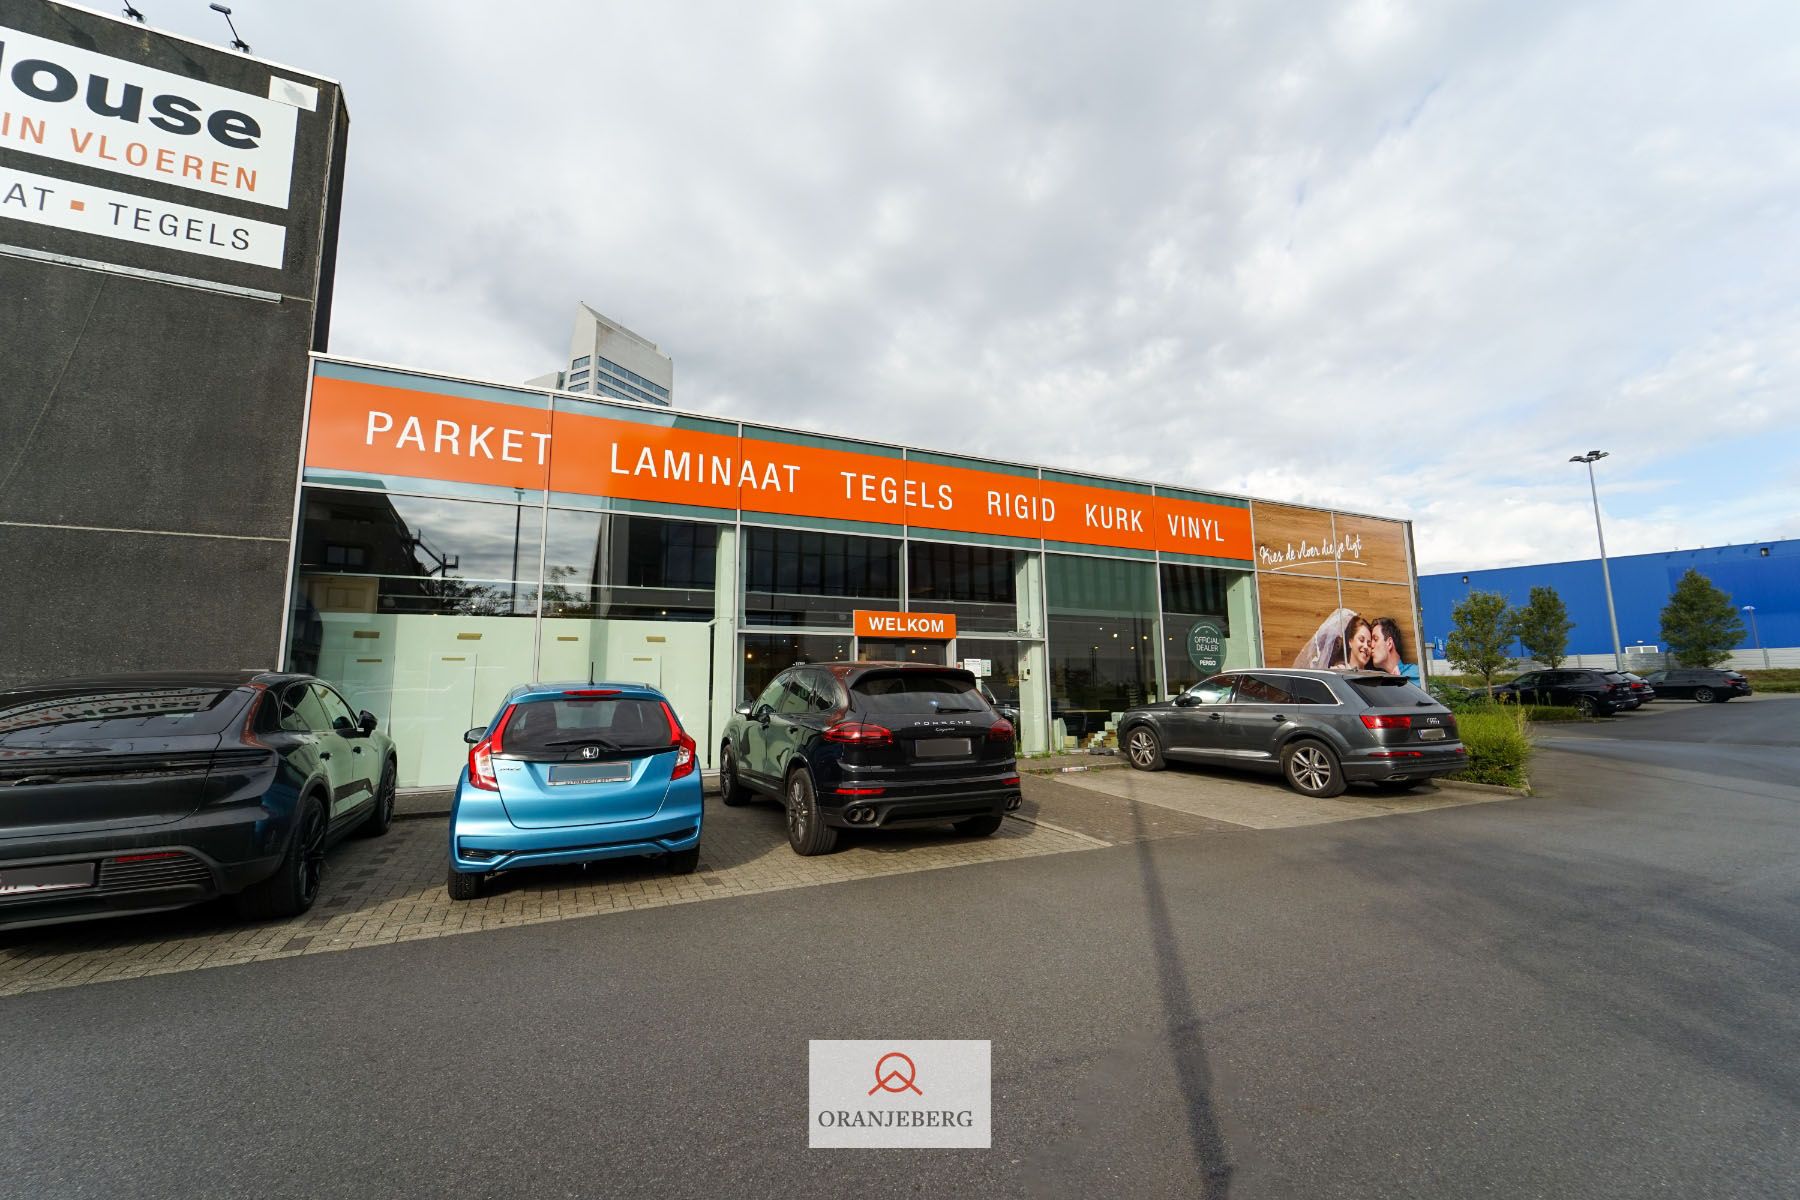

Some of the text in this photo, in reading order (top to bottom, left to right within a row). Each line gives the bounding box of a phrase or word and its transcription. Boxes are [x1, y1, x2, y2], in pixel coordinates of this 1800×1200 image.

[1, 112, 257, 192] IN VLOEREN
[108, 202, 250, 250] TEGELS
[366, 410, 1224, 542] PARKET LAMINAAT TEGELS RIGID KURK VINYL
[1260, 546, 1284, 565] Kies
[1285, 543, 1295, 560] de
[1298, 540, 1320, 559] vloer
[1346, 533, 1362, 558] ligt
[868, 616, 944, 633] WELKOM
[1194, 636, 1219, 644] OFFICIAL
[1196, 644, 1219, 652] DEALER
